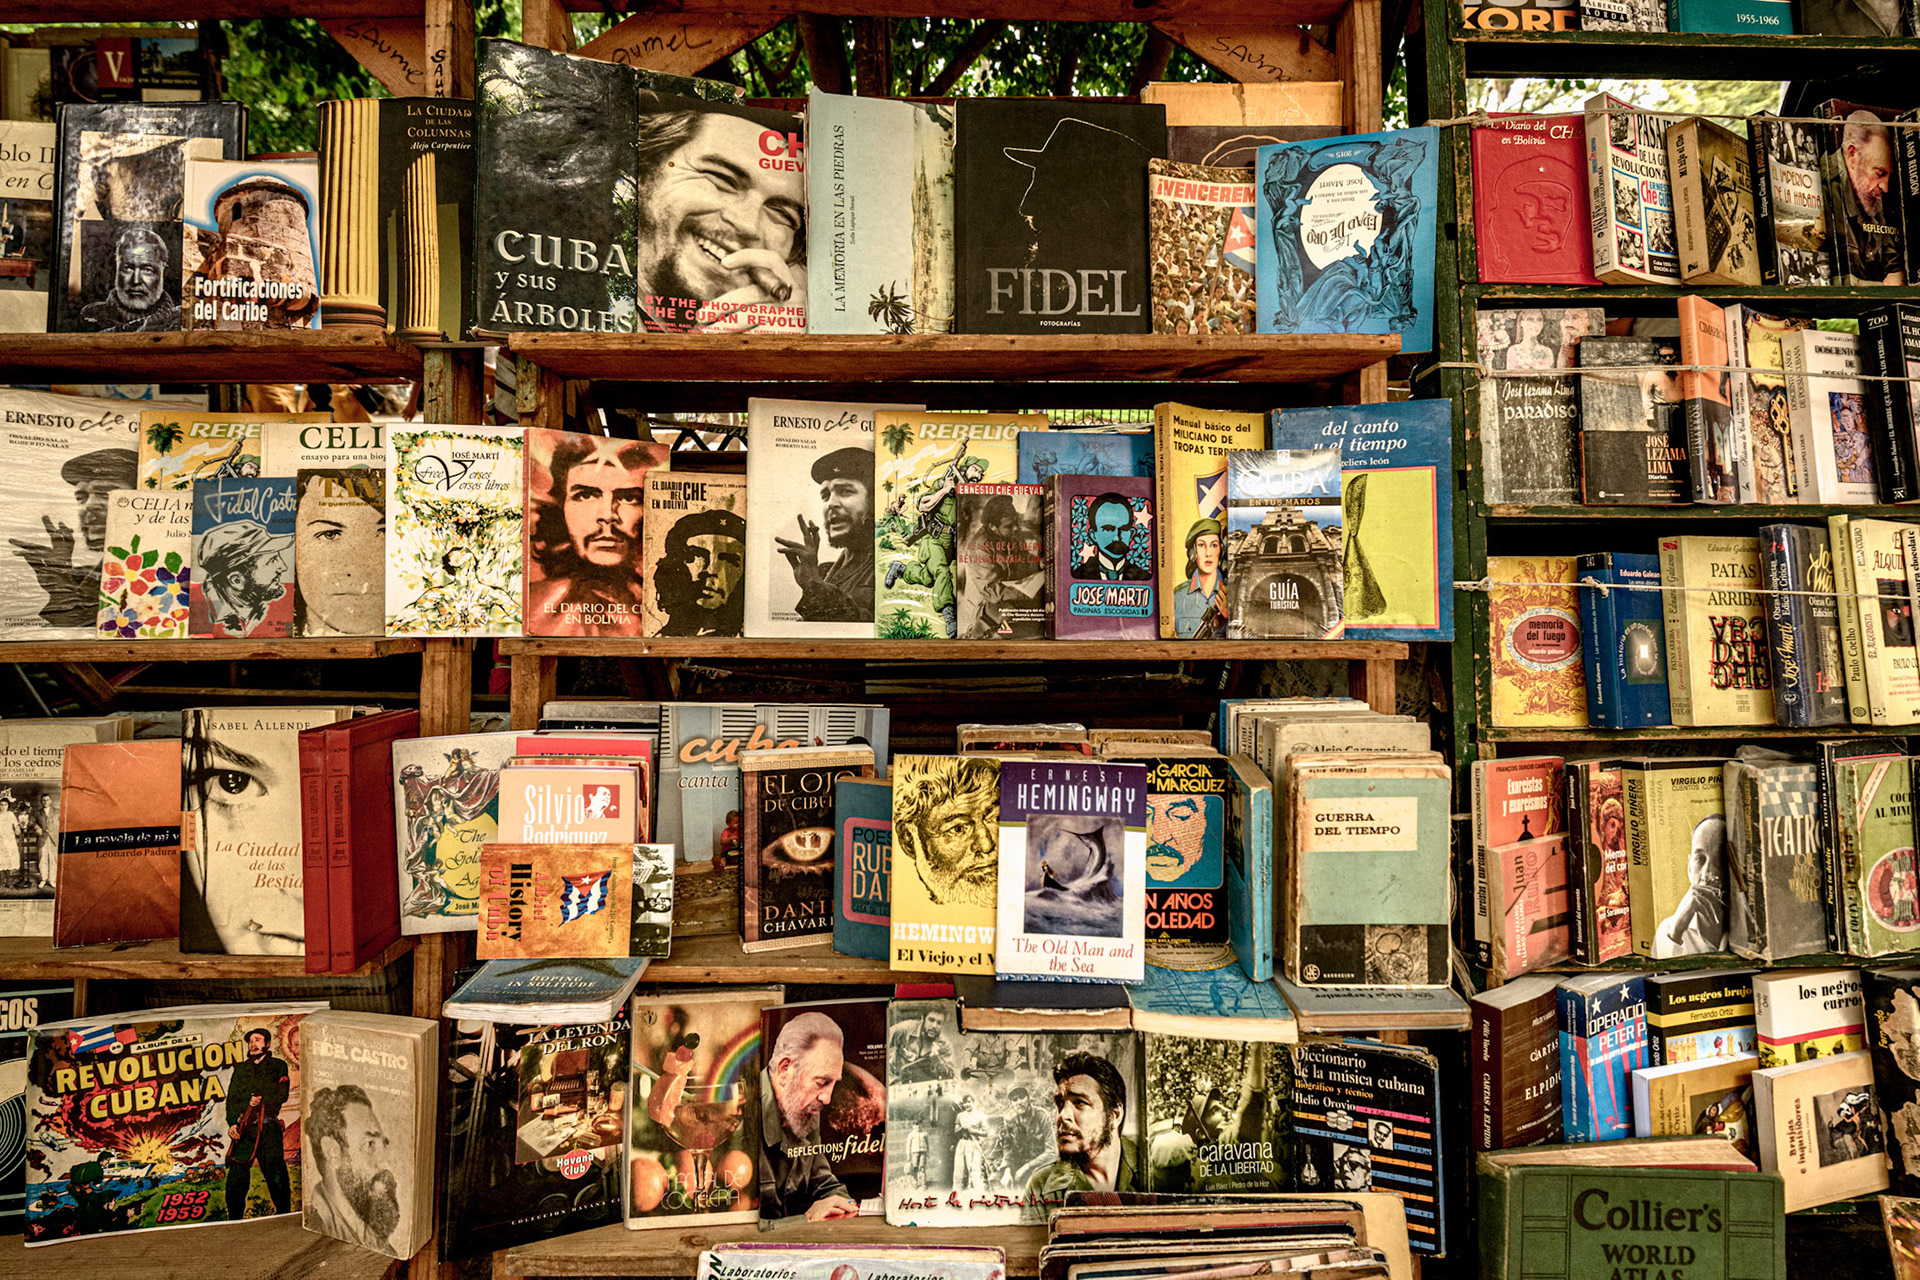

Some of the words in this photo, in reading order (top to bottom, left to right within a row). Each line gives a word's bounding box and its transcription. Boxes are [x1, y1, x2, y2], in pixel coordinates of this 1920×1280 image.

[1585, 8, 1625, 21] KORDA
[1736, 13, 1780, 26] 1955-1966
[407, 105, 422, 116] LA
[407, 126, 471, 138] COLUMNAS
[1504, 121, 1531, 131] Diario
[1534, 121, 1546, 131] del
[410, 142, 429, 151] Alejo
[431, 142, 472, 151] Carpentier
[1514, 135, 1546, 146] Bolivia
[833, 125, 845, 180] PIEDRAS
[833, 183, 845, 208] LAS
[834, 210, 845, 229] EN
[494, 230, 633, 278] CUBA
[833, 231, 846, 293] MEMORIA
[195, 276, 303, 300] Fortificaciones
[495, 271, 510, 290] y
[517, 272, 557, 291] sus
[986, 268, 1141, 316] FIDEL
[194, 301, 218, 321] del
[222, 301, 268, 323] Caribe
[834, 295, 846, 312] LA
[490, 293, 633, 333] ÁRBOLES
[1867, 315, 1888, 327] 700
[1040, 319, 1081, 327] FOTOGRAFÍAS
[773, 416, 821, 430] ERNESTO
[1174, 416, 1201, 429] Manual
[1204, 420, 1231, 432] básico
[1235, 423, 1250, 432] del
[1322, 421, 1346, 436] del
[1353, 419, 1399, 435] canto
[1174, 429, 1218, 444] MILICIANO
[1222, 435, 1233, 444] DE
[1646, 434, 1669, 447] JOSÉ
[1174, 441, 1204, 455] TROPAS
[1349, 437, 1408, 454] tiempo
[1647, 448, 1686, 460] LEZAMA
[301, 454, 328, 463] ensayo
[332, 454, 350, 463] para
[452, 451, 470, 459] JOSÉ
[475, 452, 499, 460] MARTÍ
[1370, 456, 1390, 465] león
[1647, 461, 1673, 474] LIMA
[131, 497, 180, 510] CELIA
[134, 513, 144, 525] y
[149, 512, 165, 523] de
[170, 512, 189, 523] las
[165, 530, 186, 538] Julio
[1710, 563, 1756, 578] PATAS
[1073, 586, 1103, 605] JOSE
[1106, 587, 1149, 607] MARTI
[1270, 579, 1299, 600] GUÍA
[1270, 599, 1299, 609] TURÍSTICA
[1708, 591, 1763, 606] ARRIBA
[544, 603, 558, 614] EL
[560, 603, 604, 614] DIARIO
[608, 603, 629, 614] DEL
[564, 614, 580, 624] EN
[584, 614, 631, 625] BOLIVIA
[1529, 619, 1564, 630] memoria
[1527, 630, 1539, 640] del
[1543, 630, 1566, 641] fuego
[1847, 628, 1859, 657] Coelho
[1852, 659, 1860, 682] Paulo
[1031, 769, 1124, 783] ERNEST
[1157, 763, 1212, 778] GARCIA
[678, 774, 728, 789] canta
[1156, 779, 1226, 793] MARQUEZ
[1508, 777, 1543, 795] Exorcistas
[525, 784, 585, 825] Silvio
[1017, 784, 1136, 814] HEMINGWAY
[1628, 778, 1637, 817] PIÑERA
[1502, 803, 1508, 817] y
[1509, 796, 1548, 814] exorcismos
[1315, 813, 1375, 822] GUERRA
[1314, 827, 1341, 835] DEL
[1345, 825, 1401, 835] TIEMPO
[216, 841, 233, 852] La
[237, 842, 300, 857] Ciudad
[1628, 820, 1641, 867] VIRGILIO
[249, 860, 265, 871] de
[268, 860, 285, 871] las
[1514, 855, 1526, 893] Juan
[489, 867, 508, 886] of
[534, 872, 549, 882] A
[1525, 851, 1541, 917] Rulfo
[502, 863, 532, 942] History
[533, 888, 549, 921] Brief
[487, 892, 508, 941] Cuba
[1012, 938, 1038, 954] The
[1042, 940, 1068, 956] Old
[1072, 942, 1105, 957] Man
[1110, 942, 1134, 959] and
[897, 950, 914, 962] El
[918, 950, 955, 967] Viejo
[958, 955, 968, 967] y
[969, 953, 984, 966] el
[1049, 955, 1068, 971] the
[1071, 958, 1095, 974] Sea
[1669, 994, 1686, 1005] Los
[1688, 990, 1722, 1003] negros
[1799, 985, 1817, 1000] los
[1821, 979, 1863, 995] negros
[1824, 996, 1863, 1010] curros
[1690, 1011, 1718, 1020] Fernando
[1719, 1008, 1734, 1017] Ortiz
[529, 1033, 549, 1044] LA
[555, 1019, 631, 1040] LEYENDA
[135, 1041, 167, 1054] ALBUM
[171, 1038, 185, 1047] DE
[186, 1036, 199, 1045] LA
[544, 1042, 578, 1055] DEL
[582, 1033, 618, 1048] RON
[312, 1040, 349, 1060] FIDEL
[351, 1047, 408, 1070] CASTRO
[1295, 1047, 1366, 1069] Diccionario
[56, 1041, 244, 1093] REVOLUCION
[1294, 1064, 1308, 1077] de
[1313, 1064, 1324, 1079] la
[1328, 1068, 1373, 1086] música
[1377, 1078, 1425, 1096] cubana
[89, 1075, 227, 1119] CUBANA
[1295, 1092, 1319, 1106] Helio
[1322, 1096, 1356, 1111] Orovio
[1795, 1098, 1806, 1166] inquisidores
[787, 1143, 844, 1158] REFLECTIONS
[843, 1133, 885, 1161] fidel
[1199, 1141, 1274, 1163] caravana
[557, 1153, 594, 1168] Havana
[832, 1152, 842, 1163] by
[564, 1164, 586, 1176] Club
[1200, 1165, 1212, 1177] DE
[1214, 1164, 1227, 1177] LA
[1230, 1160, 1274, 1175] LIBERTAD
[163, 1190, 209, 1208] 1952
[157, 1205, 204, 1223] 1959
[1574, 1189, 1723, 1234] Collier's
[1601, 1244, 1695, 1266] WORLD
